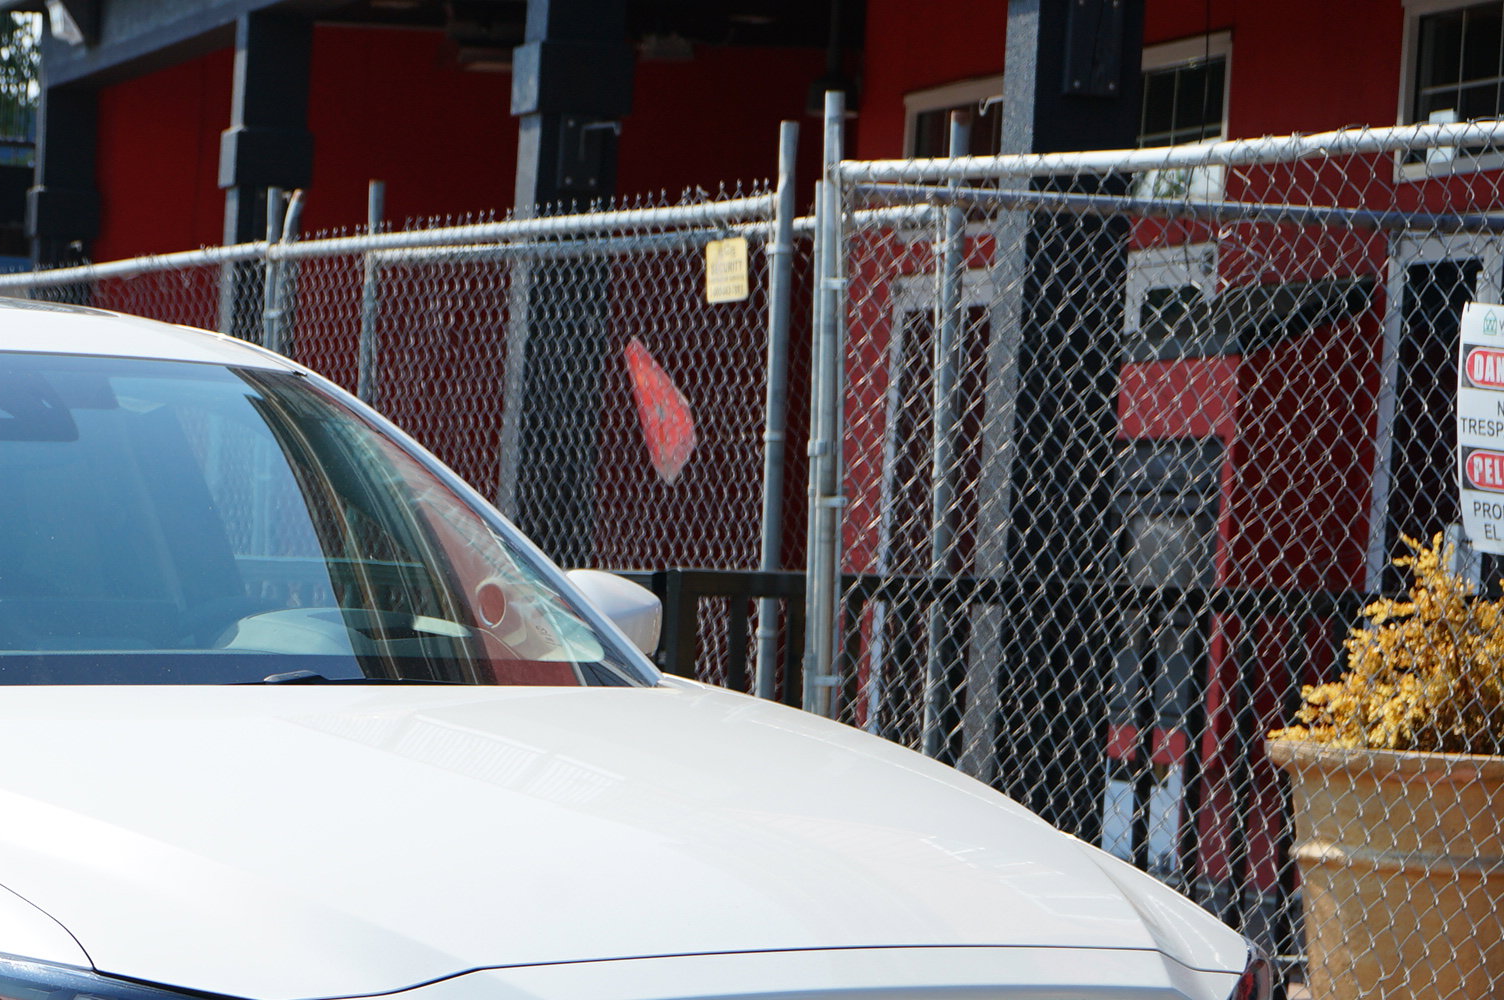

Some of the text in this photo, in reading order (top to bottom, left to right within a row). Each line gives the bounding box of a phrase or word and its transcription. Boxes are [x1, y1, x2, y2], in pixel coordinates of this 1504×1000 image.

[1460, 416, 1504, 437] TRESP
[1473, 501, 1504, 520] PRO
[1483, 523, 1502, 542] EL
